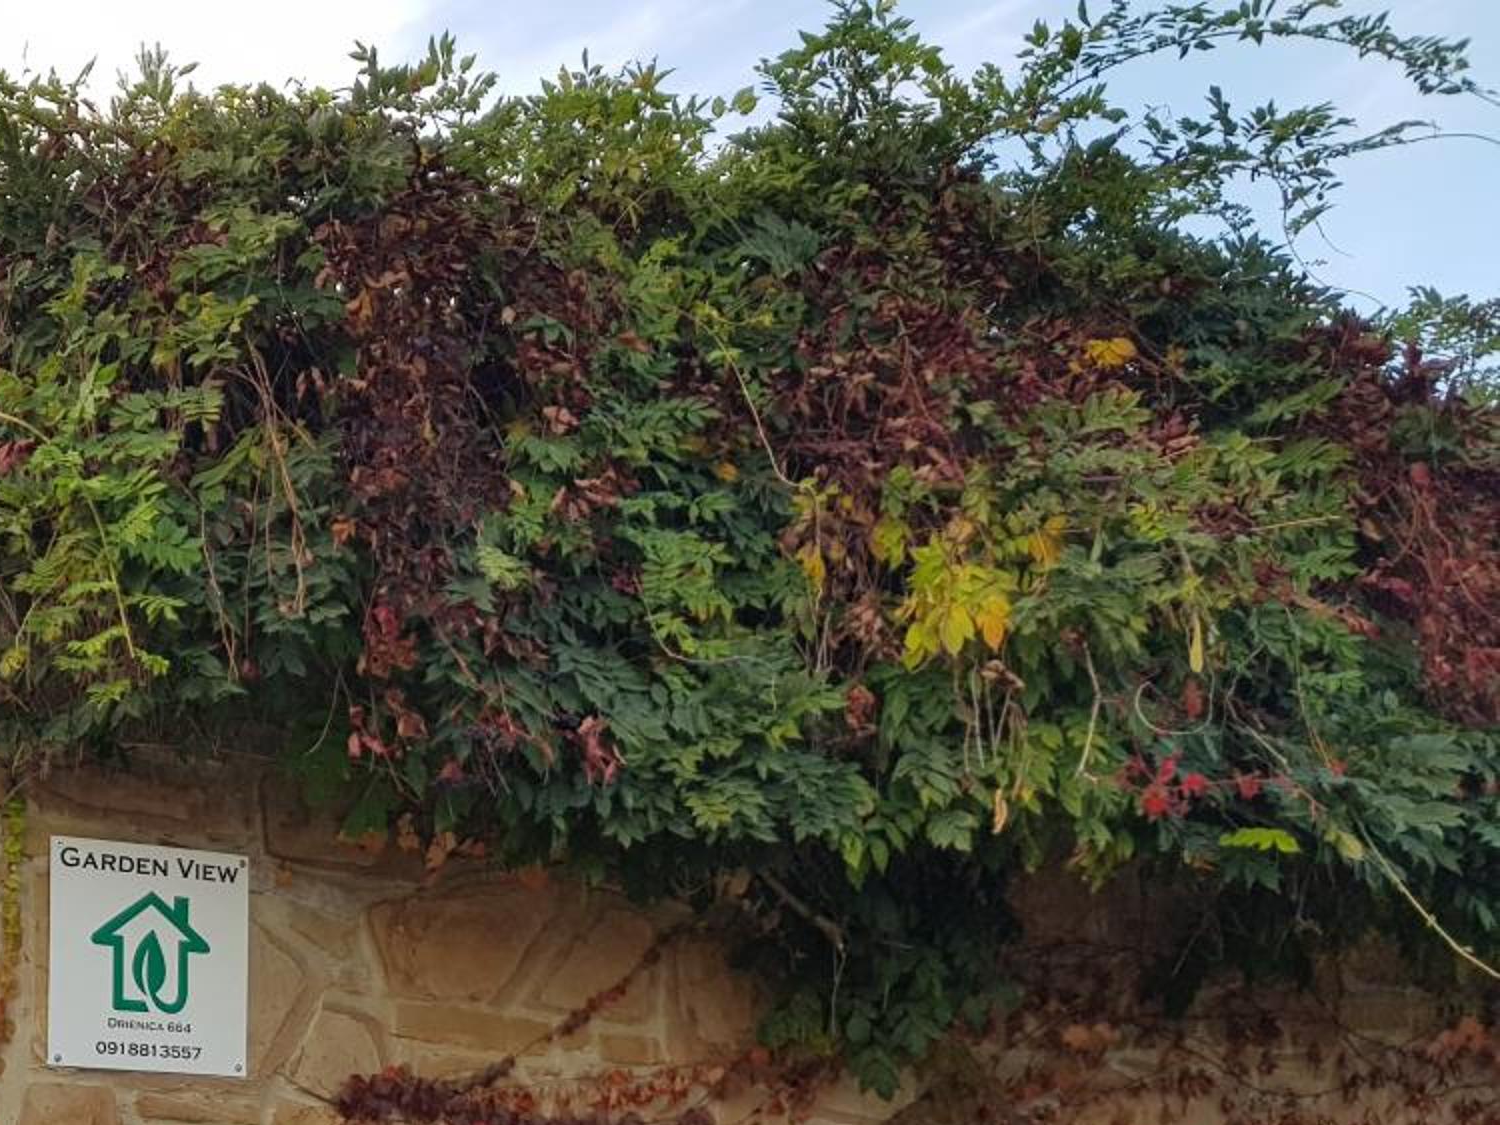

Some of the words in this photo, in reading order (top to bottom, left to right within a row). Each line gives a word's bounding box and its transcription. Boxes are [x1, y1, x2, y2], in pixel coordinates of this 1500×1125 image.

[60, 847, 169, 877] GARDEN
[177, 857, 239, 883] VIEW
[95, 1041, 202, 1060] 0918813557
